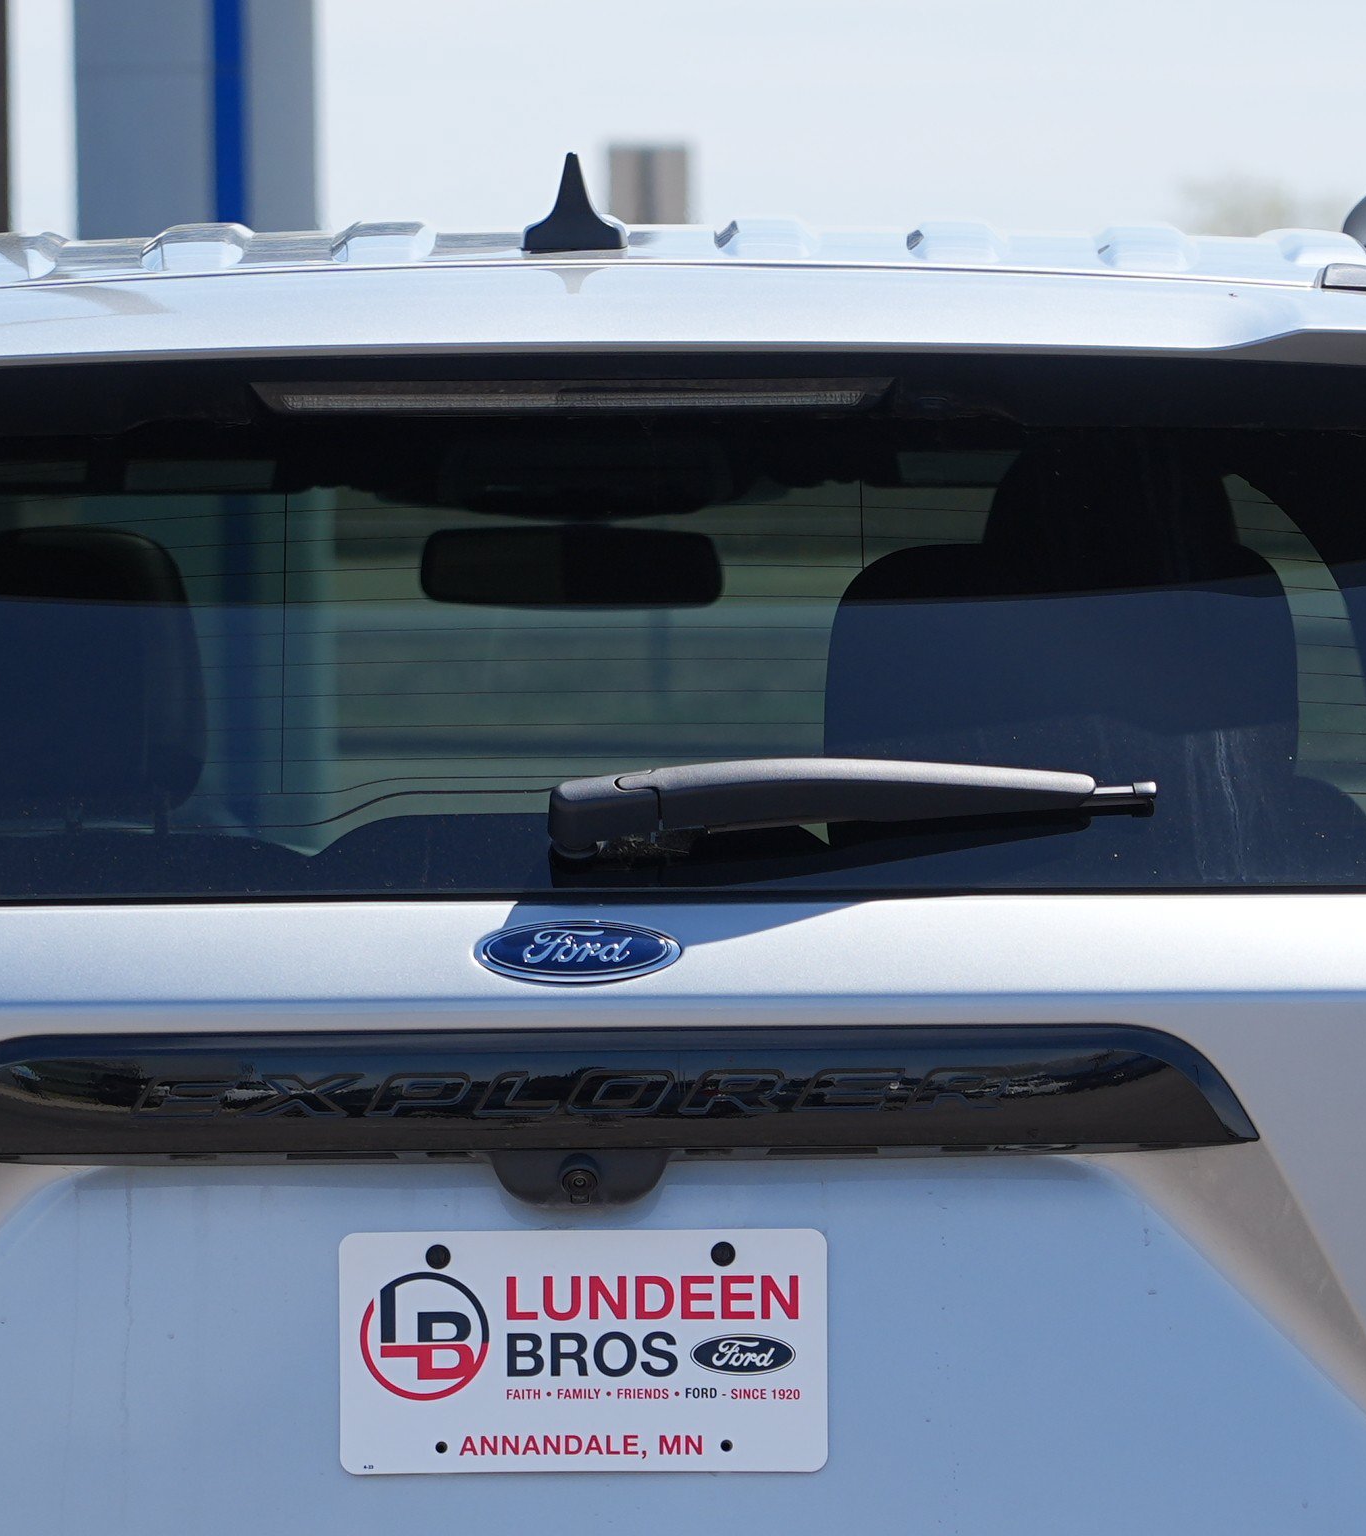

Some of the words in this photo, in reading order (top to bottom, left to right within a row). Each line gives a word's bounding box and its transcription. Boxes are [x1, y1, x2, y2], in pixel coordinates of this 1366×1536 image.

[522, 929, 633, 964] Ford
[129, 1065, 1007, 1119] EXPLORER
[506, 1275, 800, 1321] LUNDEEN
[506, 1331, 679, 1378] BROS
[711, 1339, 775, 1368] Ford
[506, 1388, 541, 1400] FAITH
[557, 1388, 601, 1400] FAMILY
[616, 1388, 669, 1400] FRIENDS
[685, 1387, 718, 1399] FORD
[730, 1388, 767, 1400] SINCE
[771, 1388, 801, 1400] 1920
[459, 1434, 648, 1459] ANNANDALE,
[658, 1433, 704, 1456] MN
